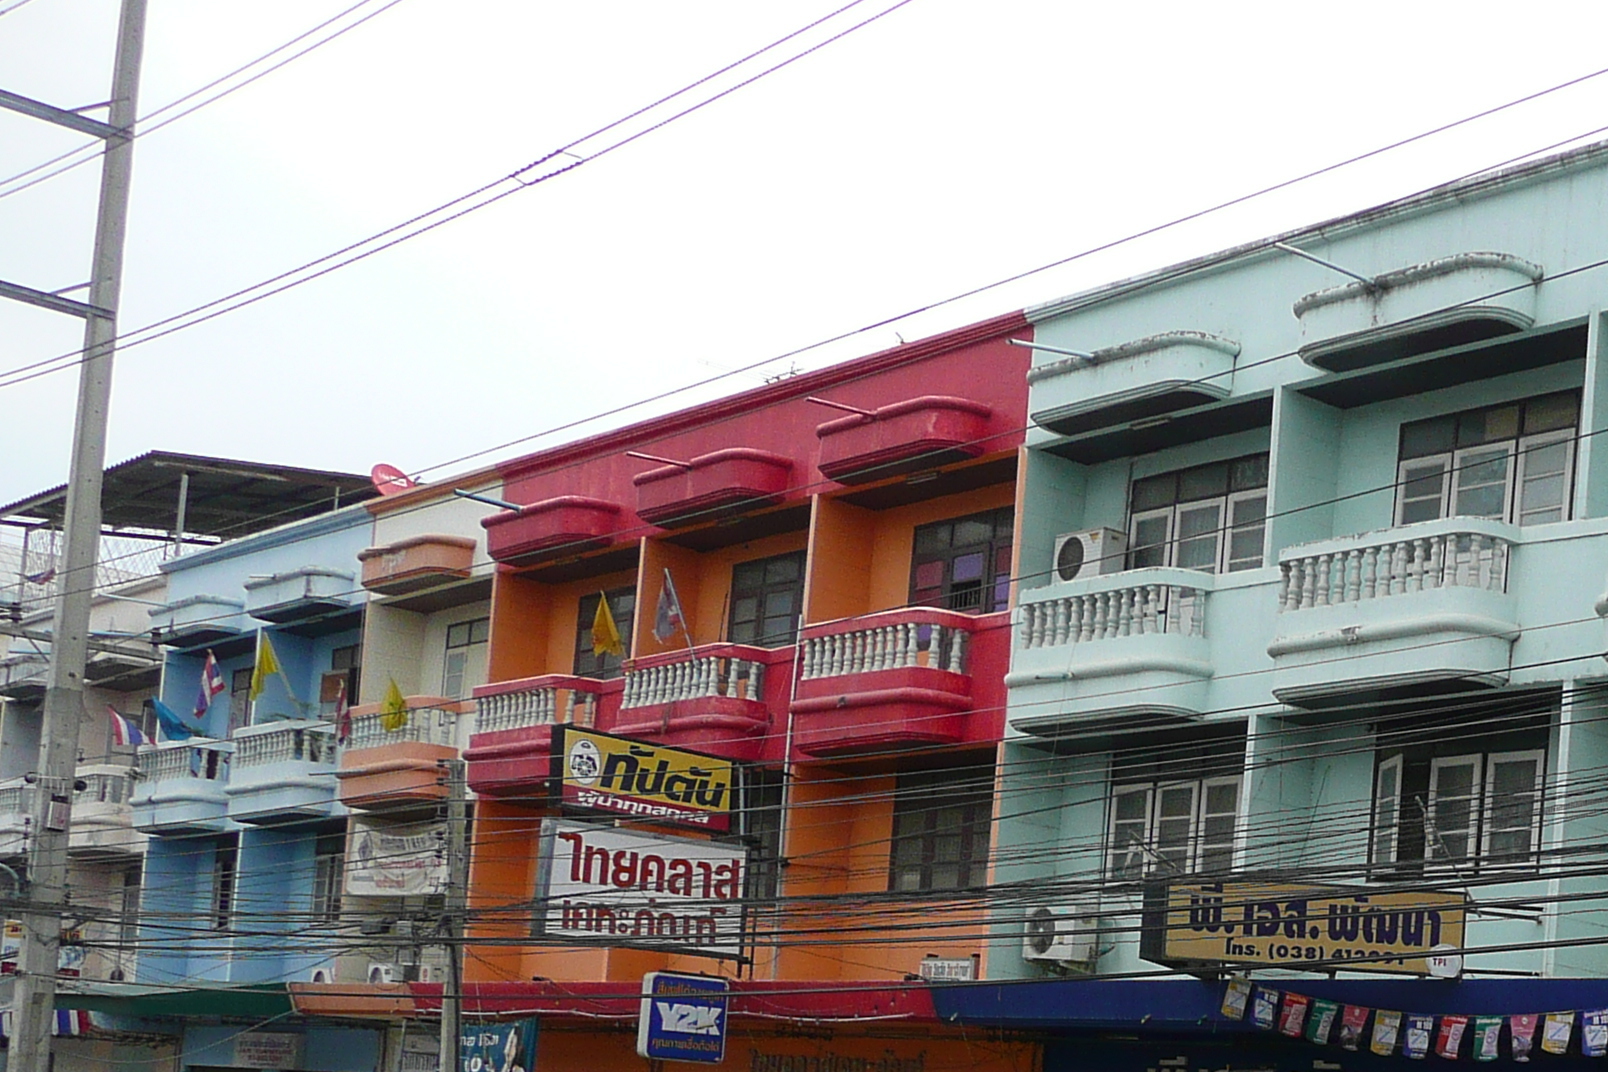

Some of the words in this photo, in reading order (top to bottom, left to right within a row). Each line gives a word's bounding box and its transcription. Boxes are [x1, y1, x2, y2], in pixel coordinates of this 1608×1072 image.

[558, 831, 741, 900] ไทยคลาส
[1224, 937, 1261, 957] โทร.
[1268, 945, 1324, 960] (038)
[656, 1001, 722, 1036] Y2K
